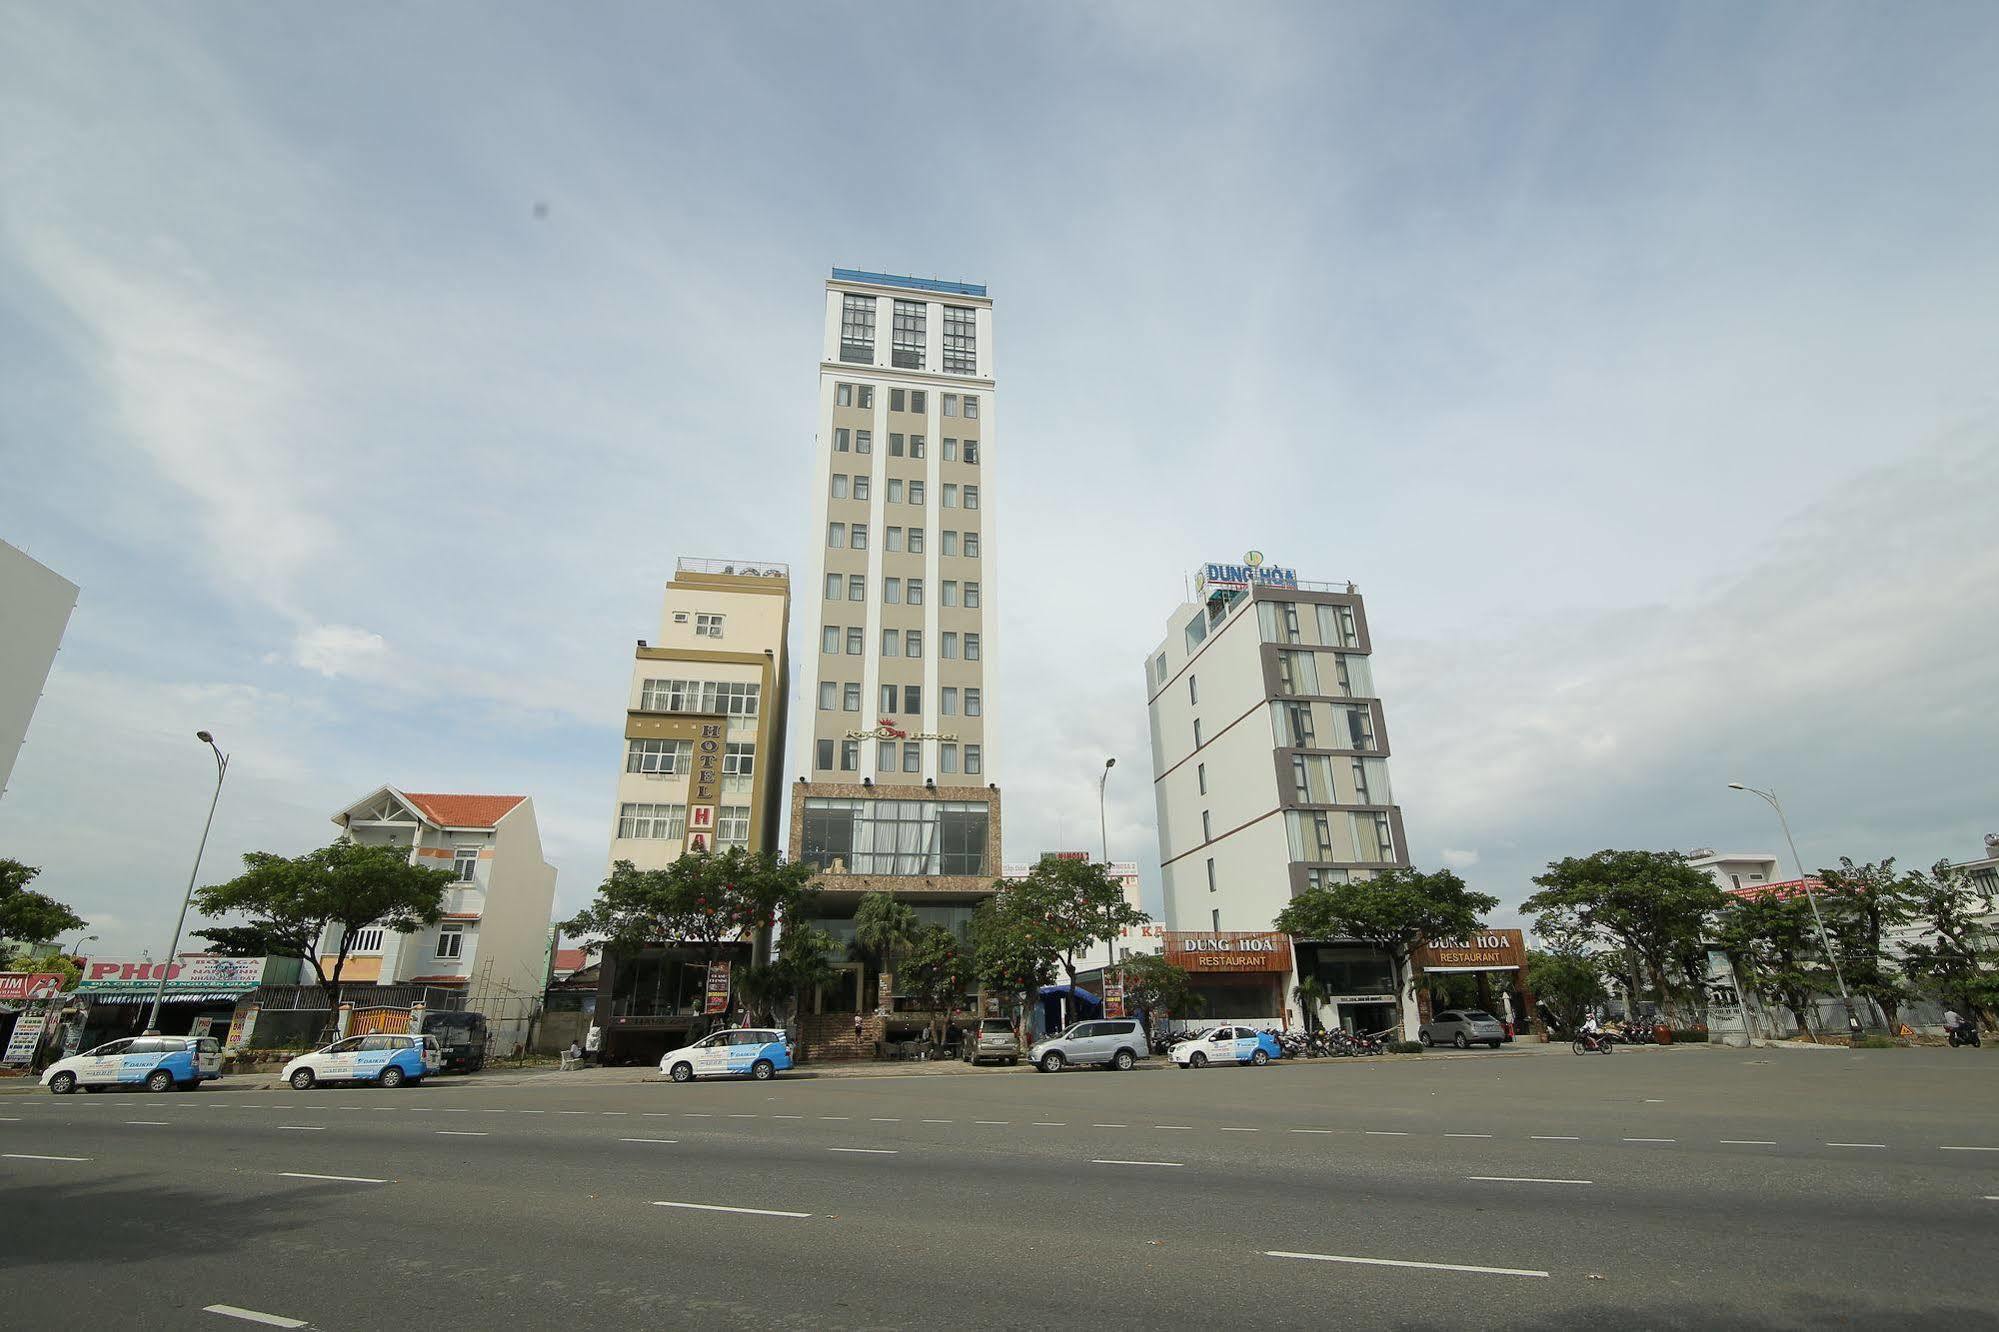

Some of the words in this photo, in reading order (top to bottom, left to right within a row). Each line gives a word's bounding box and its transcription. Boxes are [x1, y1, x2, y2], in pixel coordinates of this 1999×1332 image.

[1208, 565, 1253, 582] DUNG
[697, 725, 721, 799] HOTEL
[1185, 939, 1230, 951] DUNG
[1240, 934, 1273, 951] HÒA
[1476, 931, 1510, 948] HÒA
[1200, 956, 1266, 966] RESTAURANT
[1440, 952, 1500, 962] RESTAURANT
